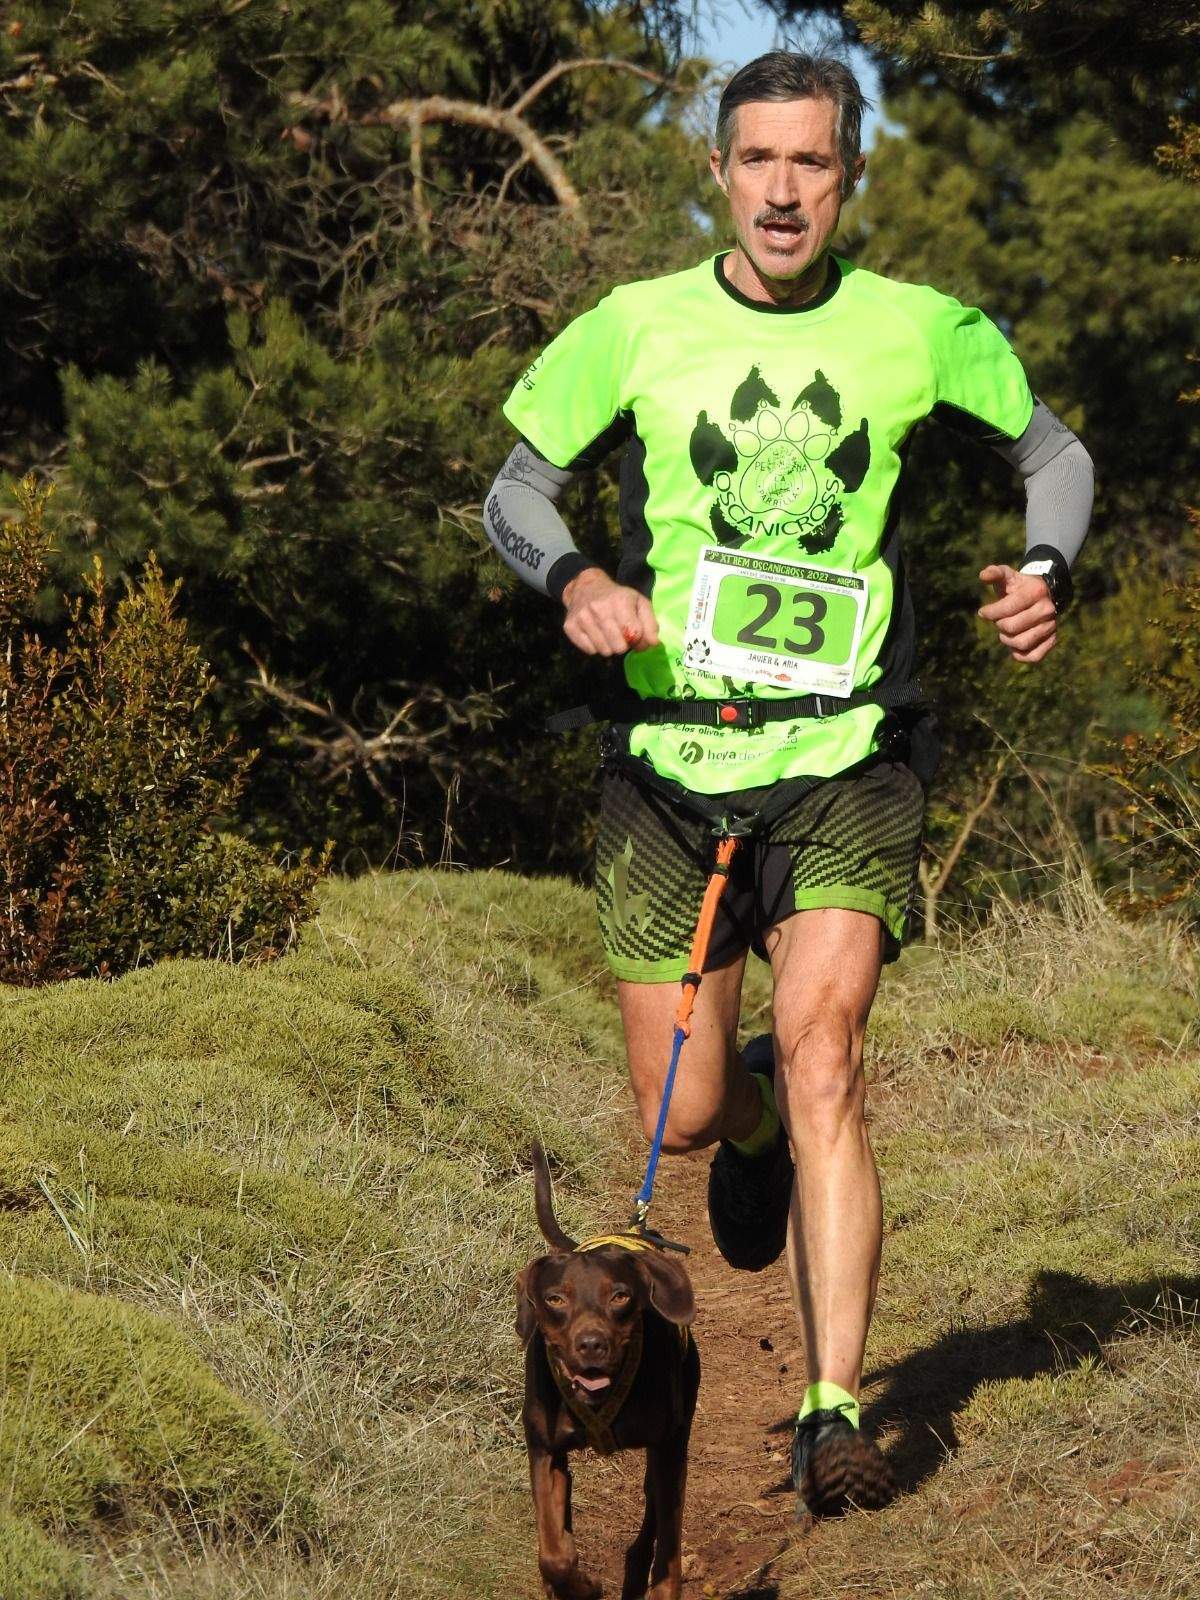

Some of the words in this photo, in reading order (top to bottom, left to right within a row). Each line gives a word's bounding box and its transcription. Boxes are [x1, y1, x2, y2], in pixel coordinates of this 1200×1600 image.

[716, 472, 840, 536] OSCANICROSS
[487, 494, 546, 570] OSCANICROSS
[752, 560, 805, 579] OSCANICROSS
[736, 583, 826, 655] 23
[748, 653, 773, 666] JAVIER
[782, 659, 799, 670] ARIA
[698, 727, 726, 738] olivos
